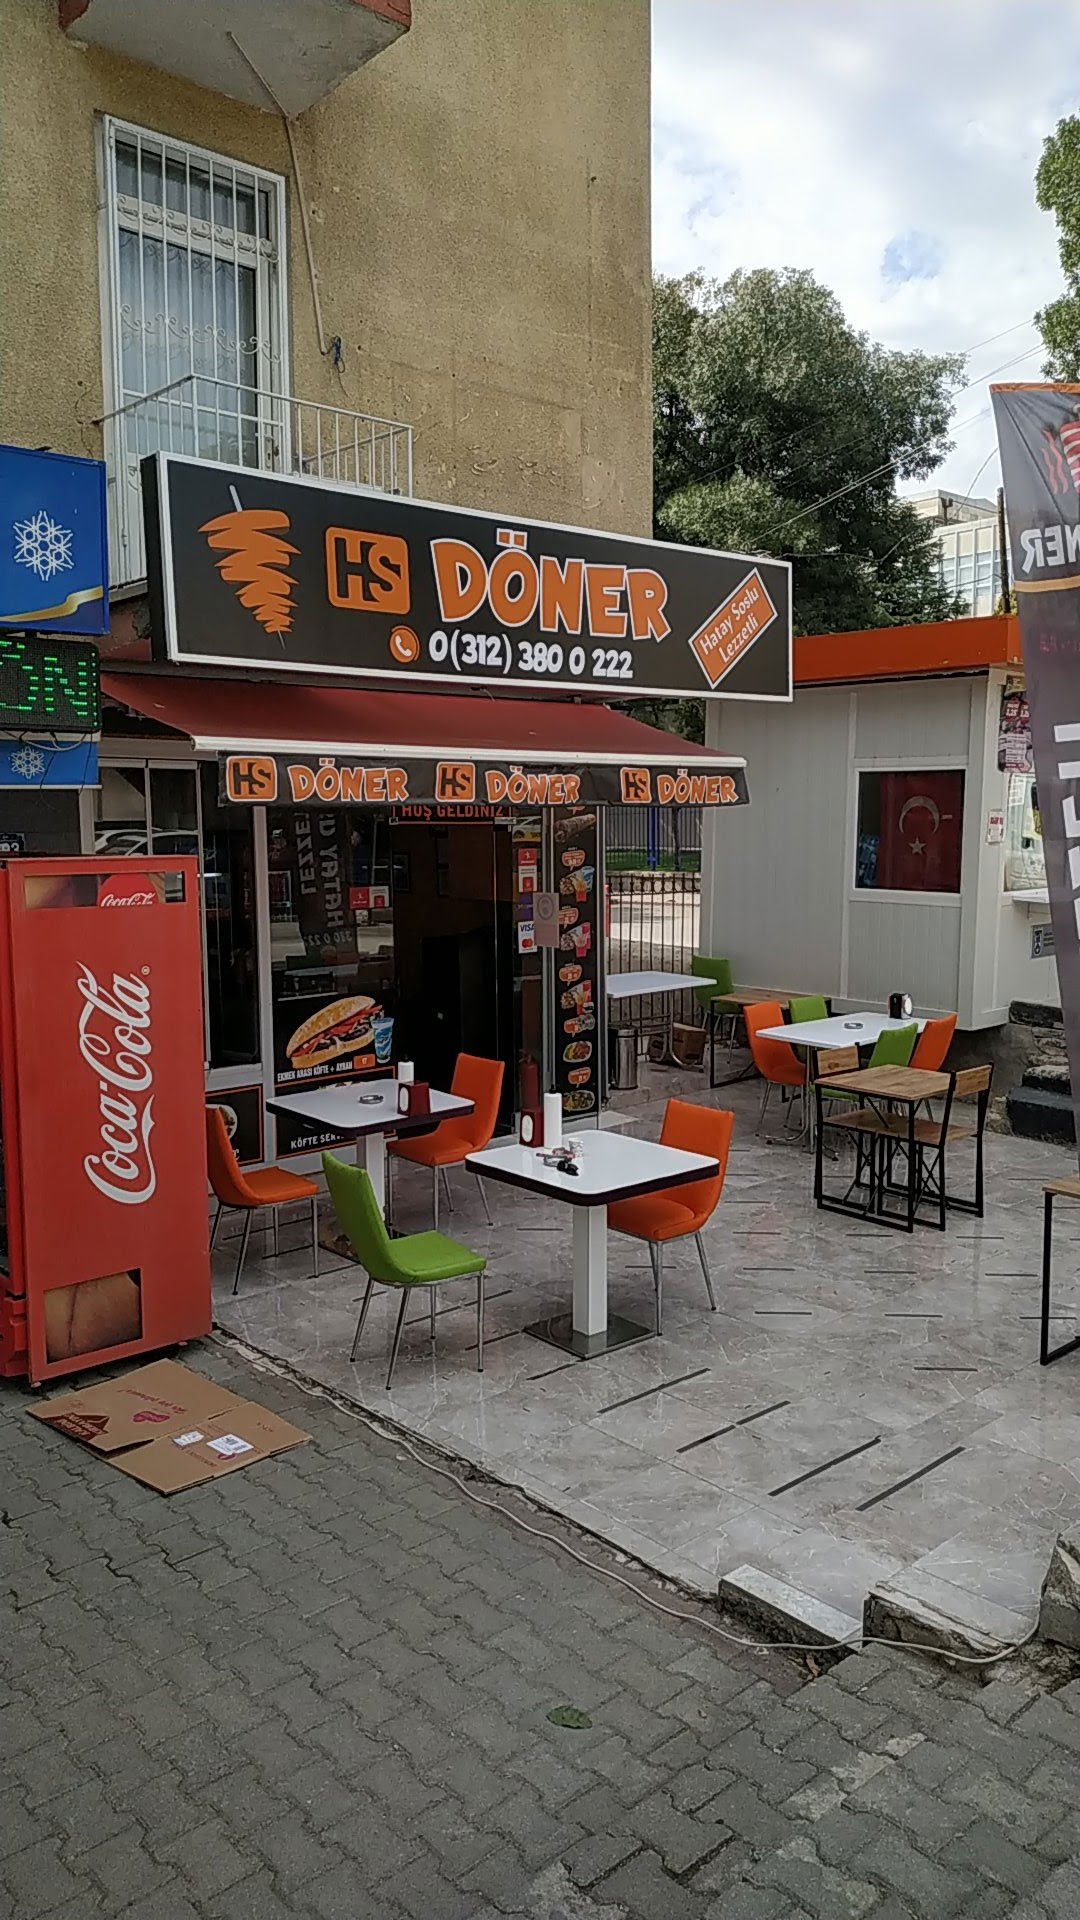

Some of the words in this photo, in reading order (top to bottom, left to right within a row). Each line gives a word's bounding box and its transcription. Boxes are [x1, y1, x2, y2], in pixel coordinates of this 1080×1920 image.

[332, 535, 403, 604] HS
[430, 528, 672, 643] DÖNER
[699, 615, 734, 656] Hatay
[731, 587, 760, 621] Soslu
[718, 612, 759, 664] Lezzetli
[429, 629, 513, 675] 0(312)
[517, 641, 563, 673] 380
[569, 646, 586, 675] 0
[592, 648, 633, 679] 222
[231, 758, 273, 797] HS
[286, 757, 409, 803] DÖNER
[440, 765, 471, 799] HS
[485, 765, 581, 804] DÖNER
[623, 771, 648, 800] HS
[657, 768, 738, 804] DÖNER
[77, 961, 156, 1204] Coca-Cola
[277, 1070, 296, 1082] EKMEK
[313, 1064, 329, 1075] KÖFTE
[290, 1135, 319, 1150] KÖFTE
